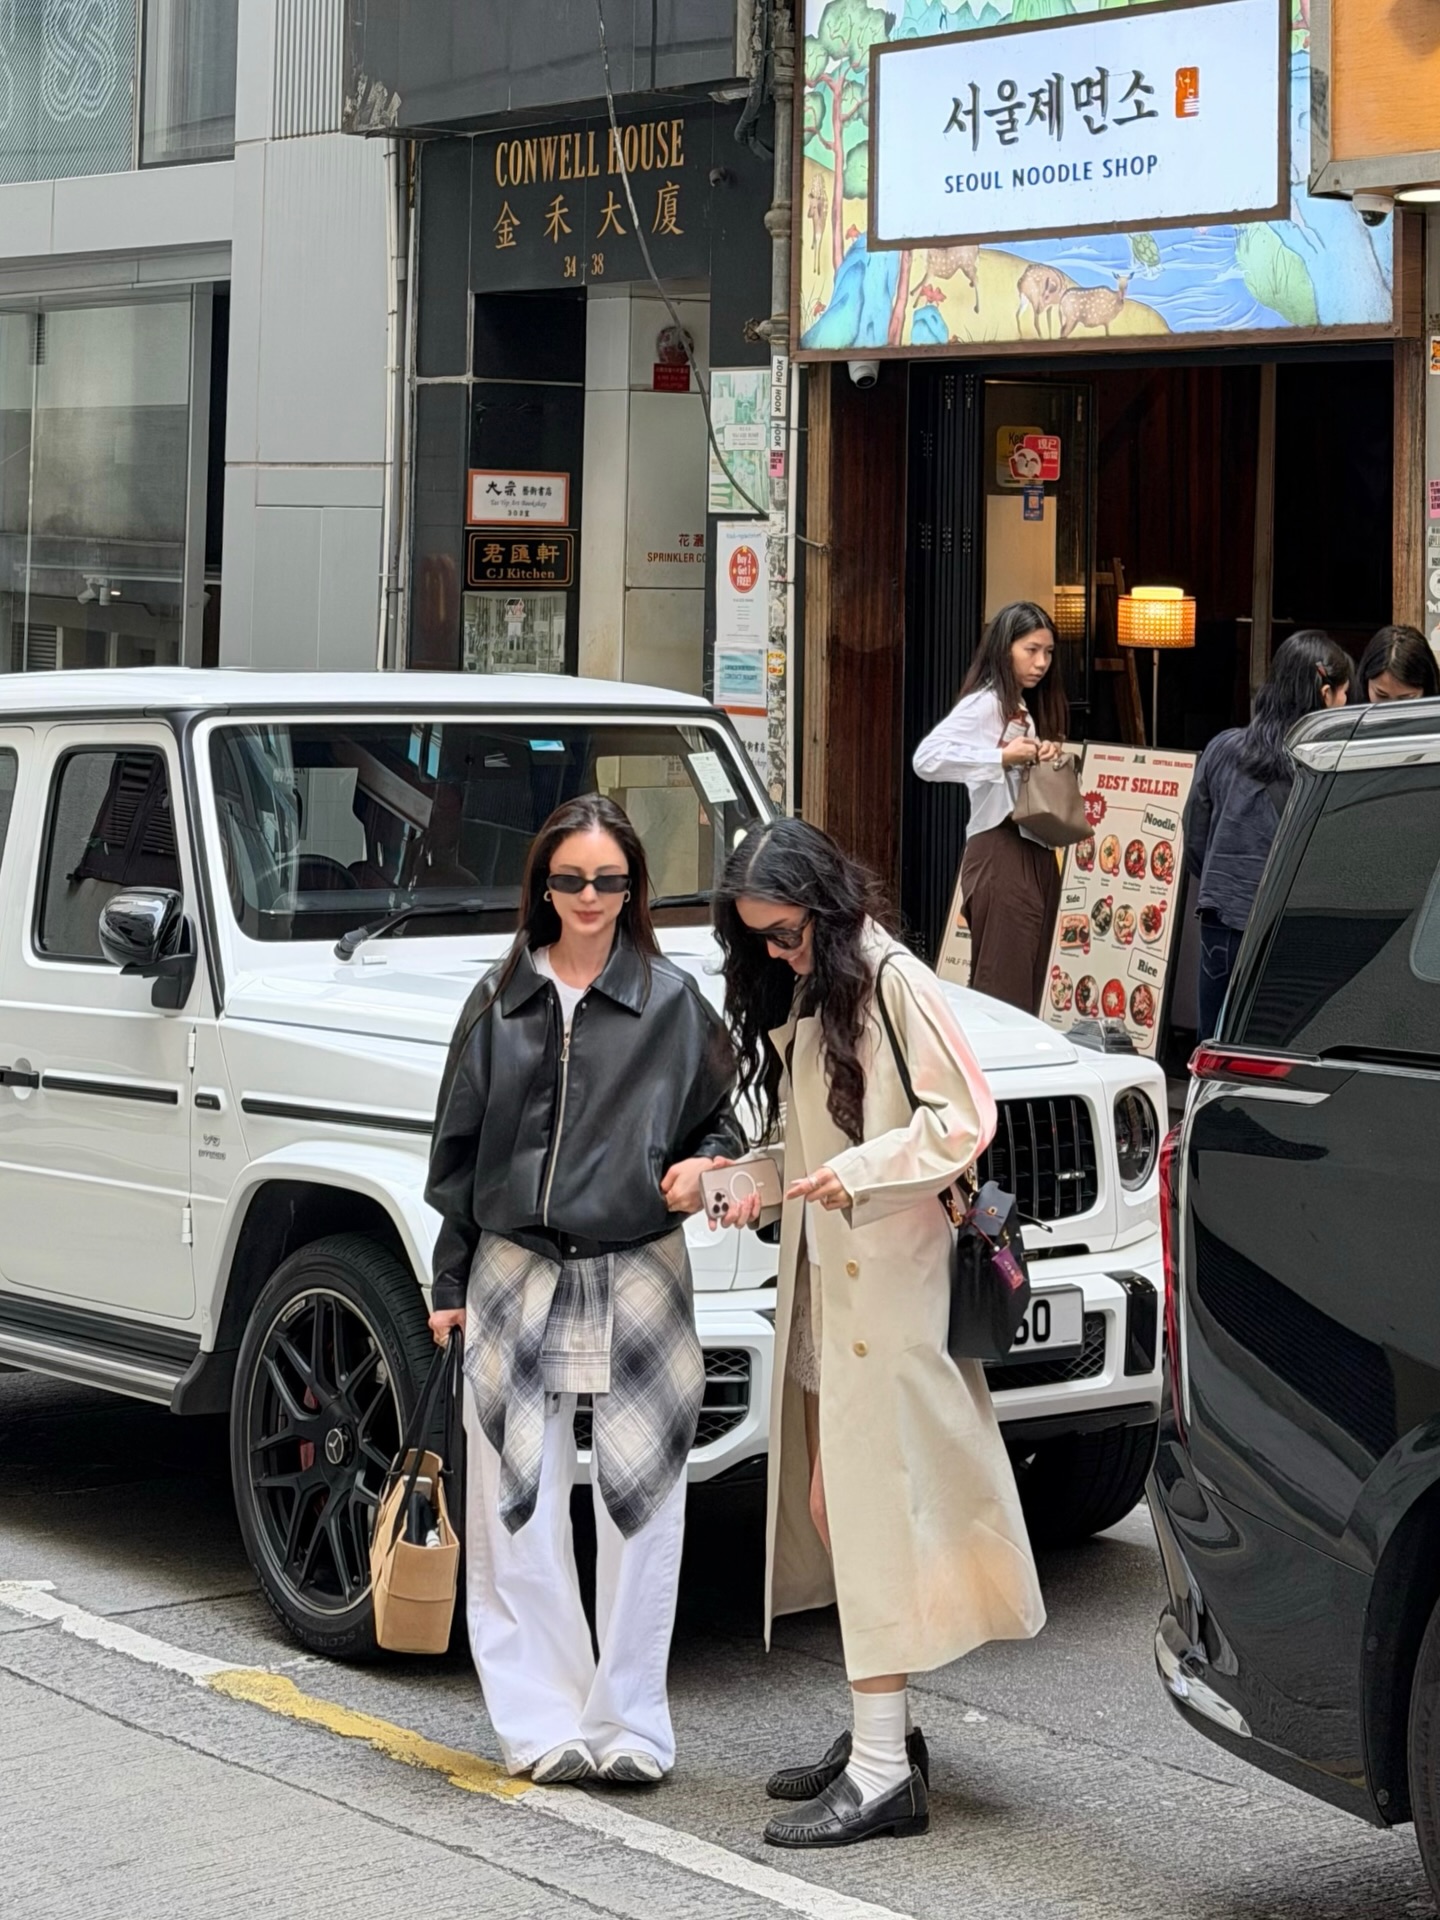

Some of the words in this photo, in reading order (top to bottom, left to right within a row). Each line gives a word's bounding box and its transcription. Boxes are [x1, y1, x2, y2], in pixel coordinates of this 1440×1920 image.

[943, 66, 1159, 151] 서울제면소
[495, 131, 600, 187] CONWELL
[607, 119, 685, 175] HOUSE
[944, 171, 1004, 194] SEOUL
[1012, 161, 1093, 188] NOODLE
[1102, 154, 1159, 178] SHOP
[493, 180, 685, 249] 金禾大廈
[563, 255, 577, 278] 34
[591, 252, 604, 275] 38
[775, 358, 784, 383] HOOK
[774, 388, 782, 413] HOOK
[647, 552, 695, 563] SPRINKLER
[736, 553, 748, 566] Buy
[507, 567, 555, 579] Kitchen
[737, 565, 748, 575] Get
[1096, 774, 1129, 792] BEST
[1131, 778, 1180, 797] SELLER
[1144, 811, 1177, 832] Noodle
[1065, 894, 1081, 904] Side
[1137, 958, 1159, 977] Rice
